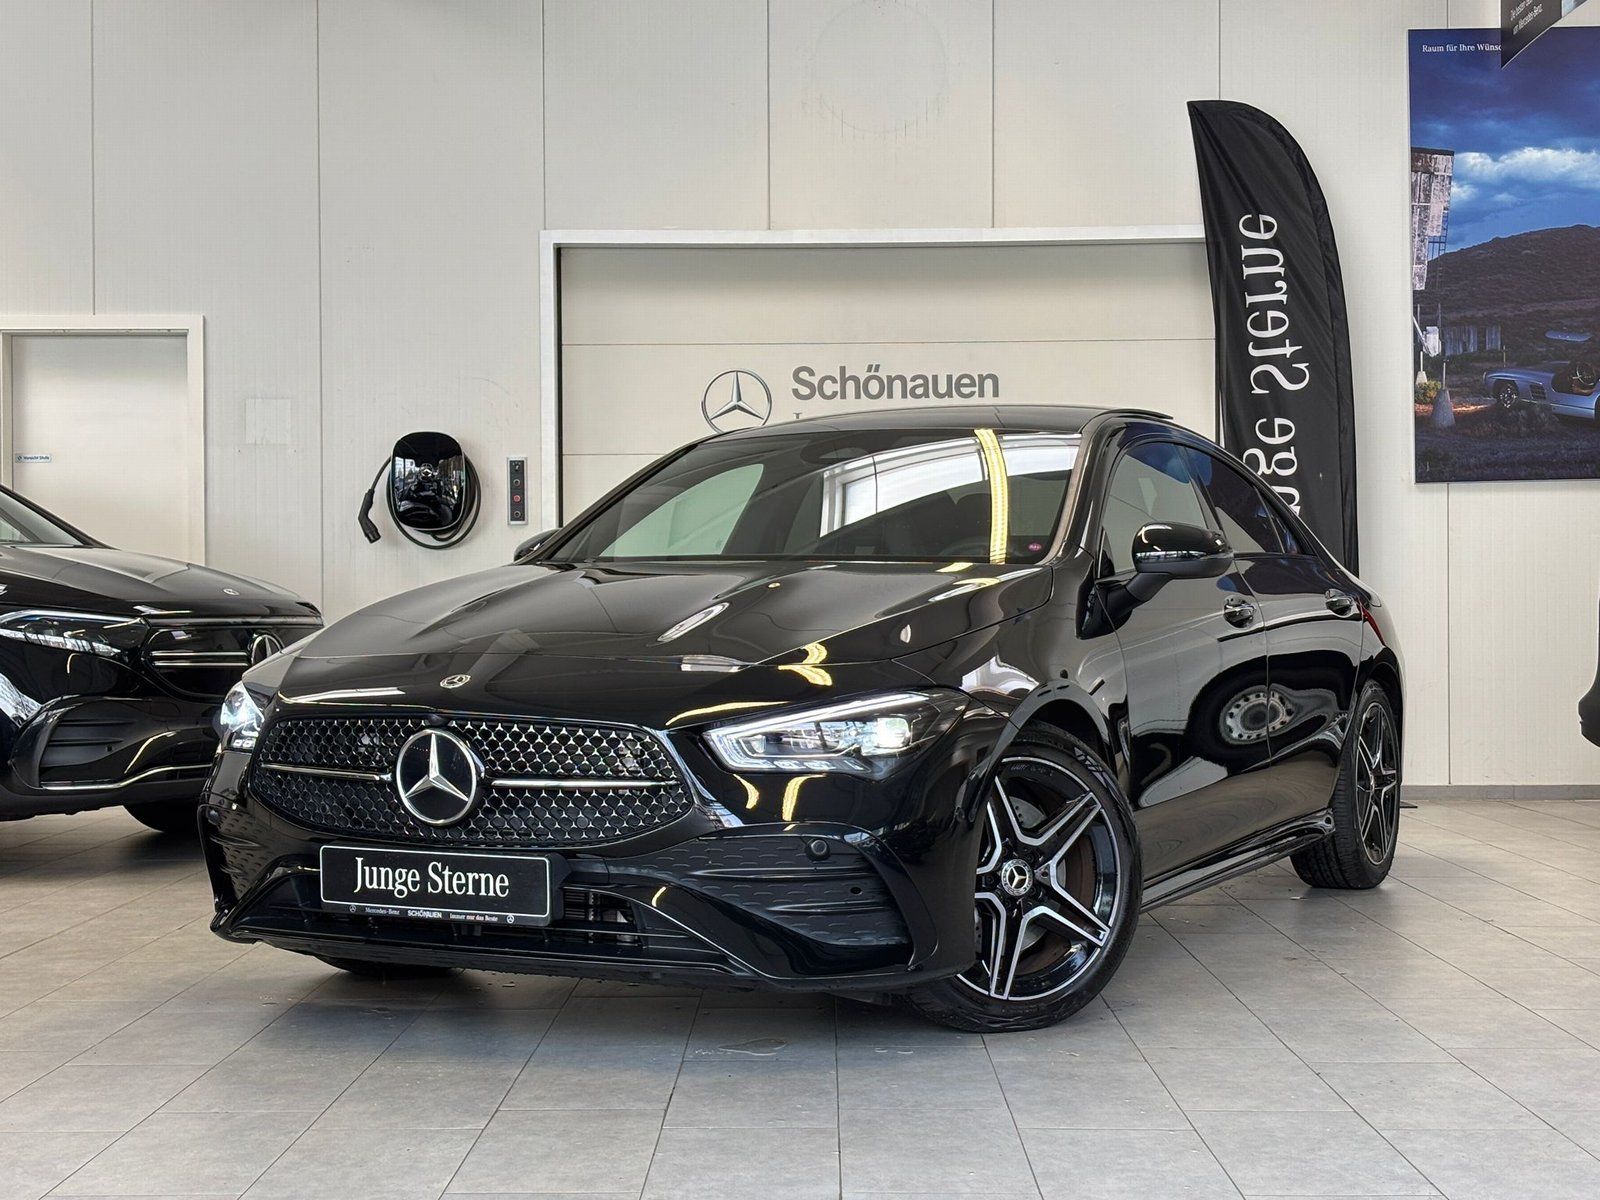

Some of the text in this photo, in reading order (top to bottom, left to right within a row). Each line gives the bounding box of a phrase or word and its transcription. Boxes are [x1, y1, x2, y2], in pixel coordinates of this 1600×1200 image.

[1422, 43, 1501, 53] Raum für Ihre Wünsc
[792, 364, 999, 400] Schönauen
[353, 857, 509, 898] Junge Sterne
